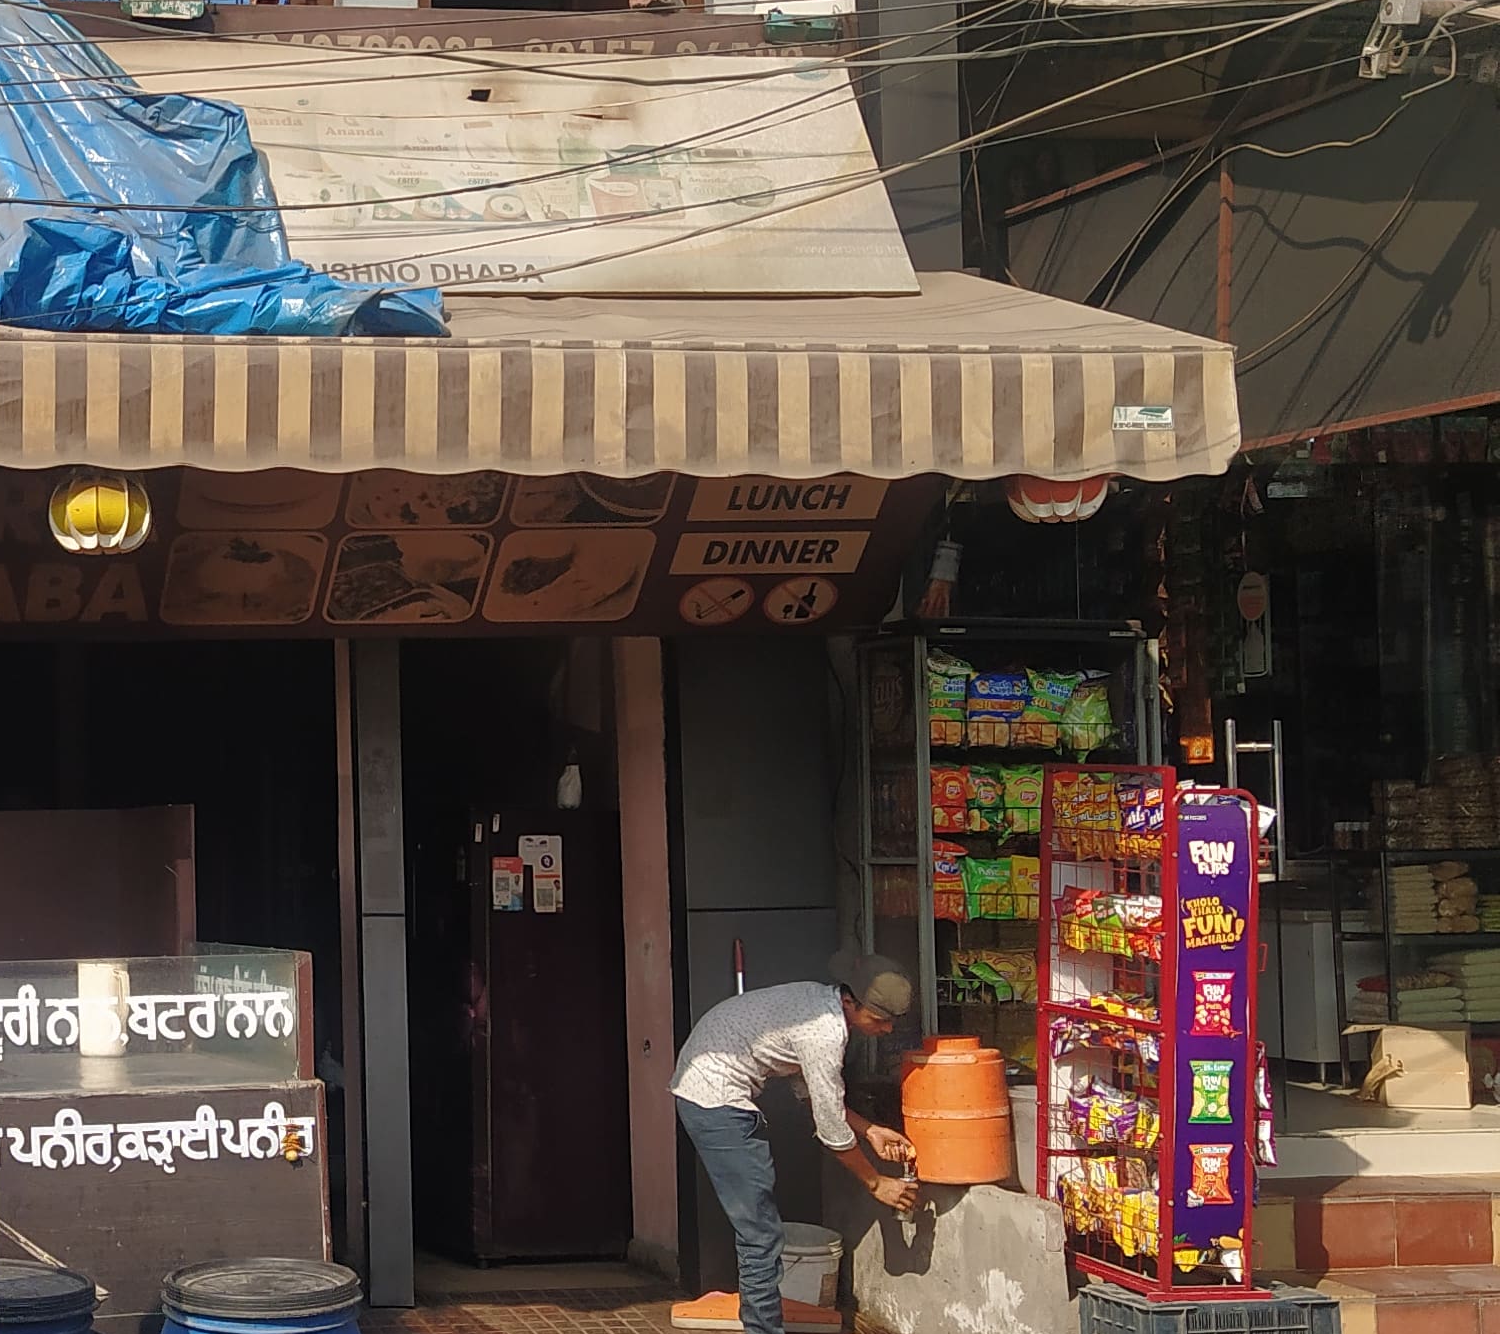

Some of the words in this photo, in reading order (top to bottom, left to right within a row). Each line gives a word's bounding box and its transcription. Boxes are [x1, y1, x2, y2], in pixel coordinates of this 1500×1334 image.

[431, 262, 545, 283] DHABA
[726, 484, 851, 512] LUNCH
[701, 538, 841, 567] DINNER
[1189, 840, 1235, 865] FUN
[223, 991, 295, 1040] ਨਾਨ
